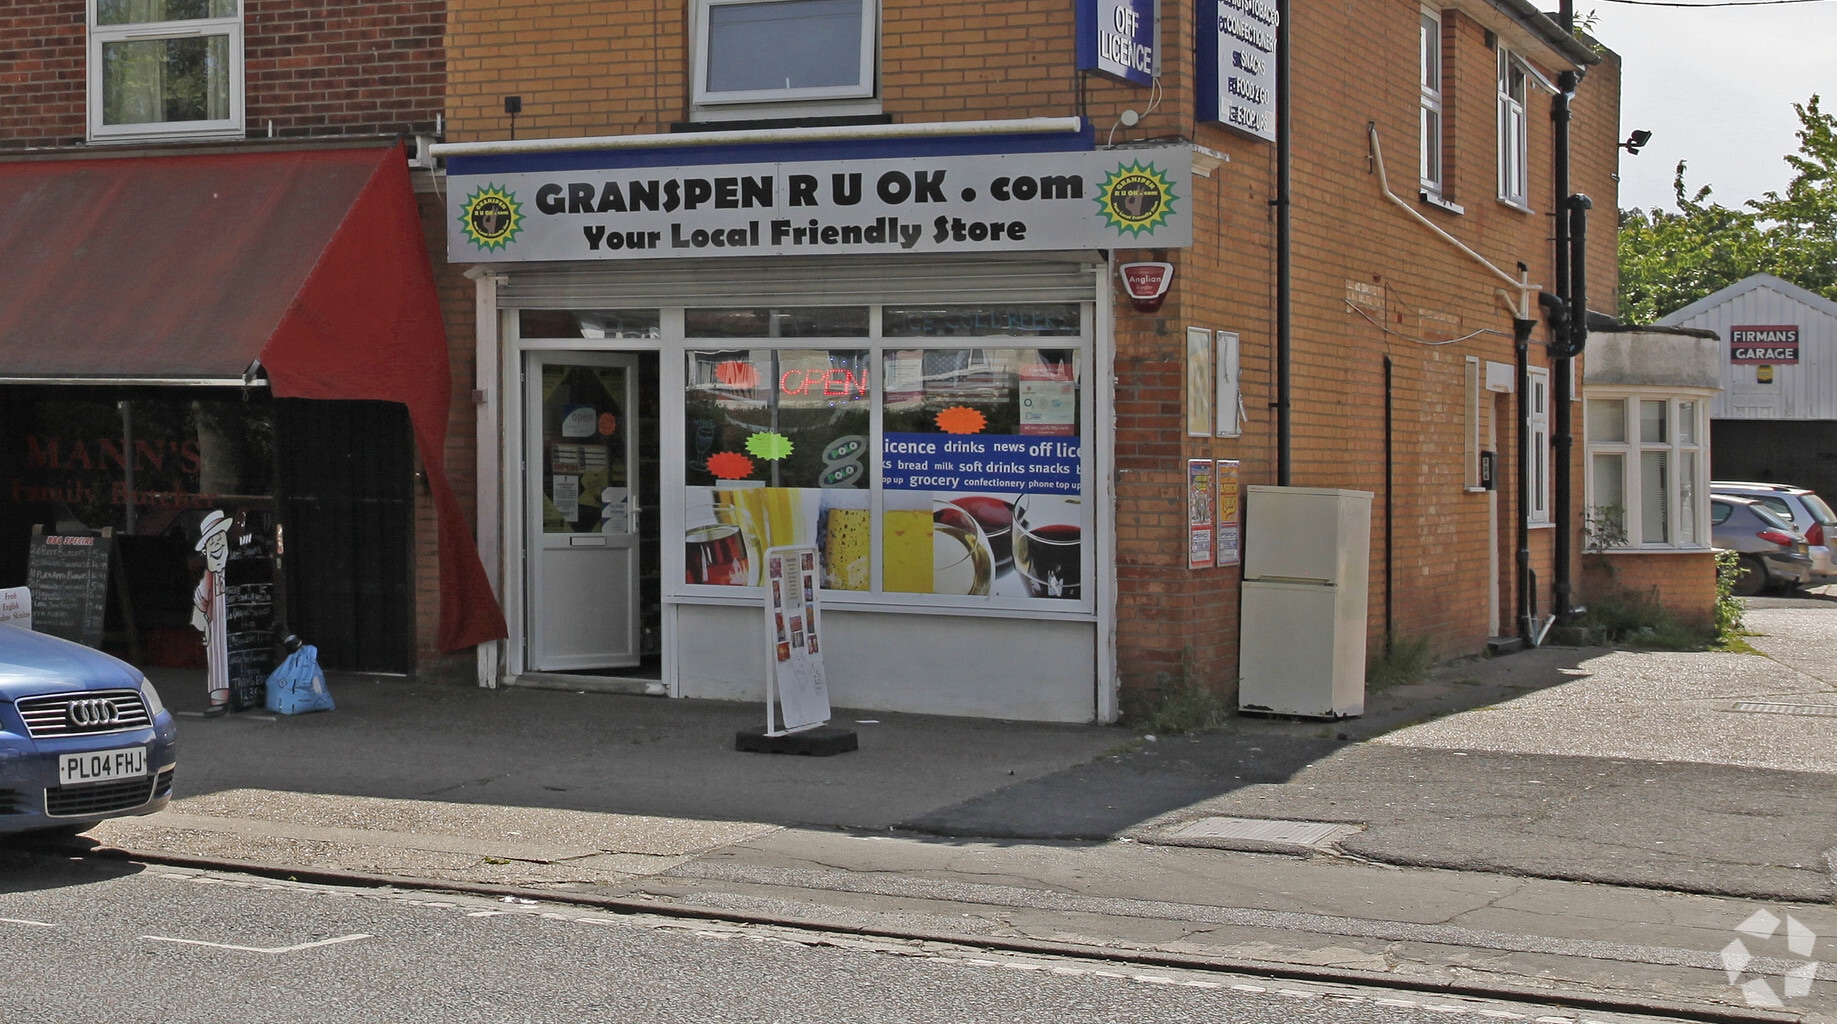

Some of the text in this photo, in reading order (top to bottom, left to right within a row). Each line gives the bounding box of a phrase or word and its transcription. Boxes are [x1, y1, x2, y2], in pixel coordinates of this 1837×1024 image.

[1114, 5, 1140, 37] OFF
[1100, 30, 1152, 74] LICENCE
[1240, 50, 1266, 76] SNACKS
[535, 176, 773, 216] GRANSPEN
[789, 174, 818, 207] R
[831, 173, 862, 205] U
[990, 175, 1083, 201] com
[583, 215, 1027, 250] Your Local Friendly Store
[1129, 274, 1162, 284] Anglian
[1733, 331, 1796, 342] FIRMANS
[1736, 348, 1794, 359] GARAGE
[780, 369, 868, 396] OPEN
[571, 412, 594, 423] open
[25, 434, 201, 474] MANN'S
[831, 441, 858, 459] POLO
[883, 439, 937, 454] icence
[944, 441, 985, 453] drinks
[994, 443, 1025, 452] news
[1029, 442, 1053, 457] off
[827, 466, 854, 483] POLO
[898, 460, 928, 470] bread
[934, 462, 953, 470] milk
[959, 461, 982, 473] soft
[986, 462, 1025, 474] drinks
[1029, 463, 1070, 474] snacks
[909, 475, 960, 489] grocery
[964, 478, 1025, 489] confectionery
[1028, 480, 1055, 489] phone
[1056, 481, 1070, 490] top
[46, 536, 95, 546] BBQ SPECIAL
[68, 751, 142, 779] PL04 FHJ
